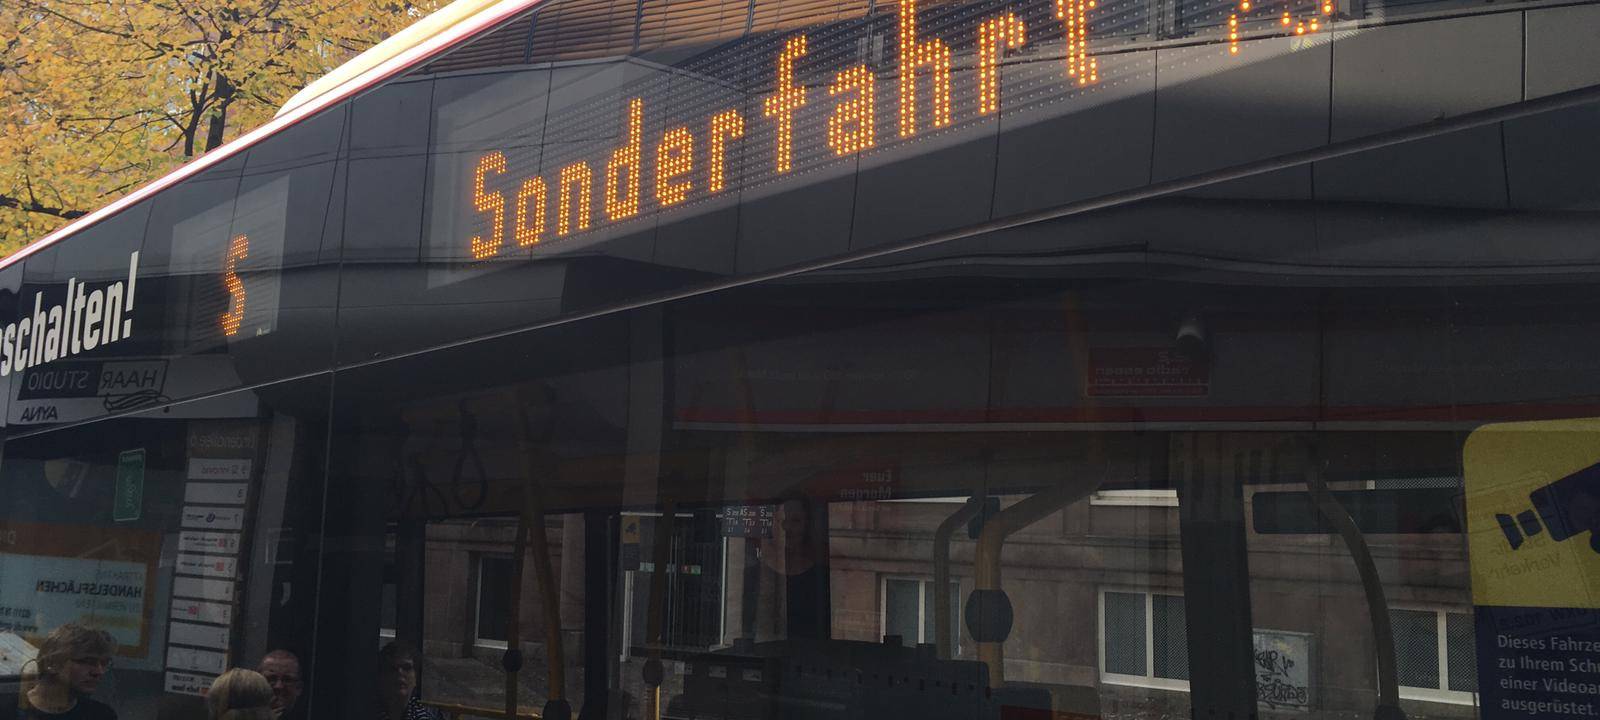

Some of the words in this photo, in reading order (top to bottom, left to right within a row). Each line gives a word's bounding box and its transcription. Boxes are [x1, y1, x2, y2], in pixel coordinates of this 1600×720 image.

[471, 0, 1099, 260] Sonderfahrt
[0, 250, 139, 377] schalten!
[1497, 634, 1546, 650] Dieses
[1499, 657, 1516, 669] zu
[1520, 655, 1565, 672] Ihrem
[1500, 677, 1538, 691] einer
[1543, 677, 1600, 695] Videoa
[1501, 698, 1599, 716] ausgerüstet.
